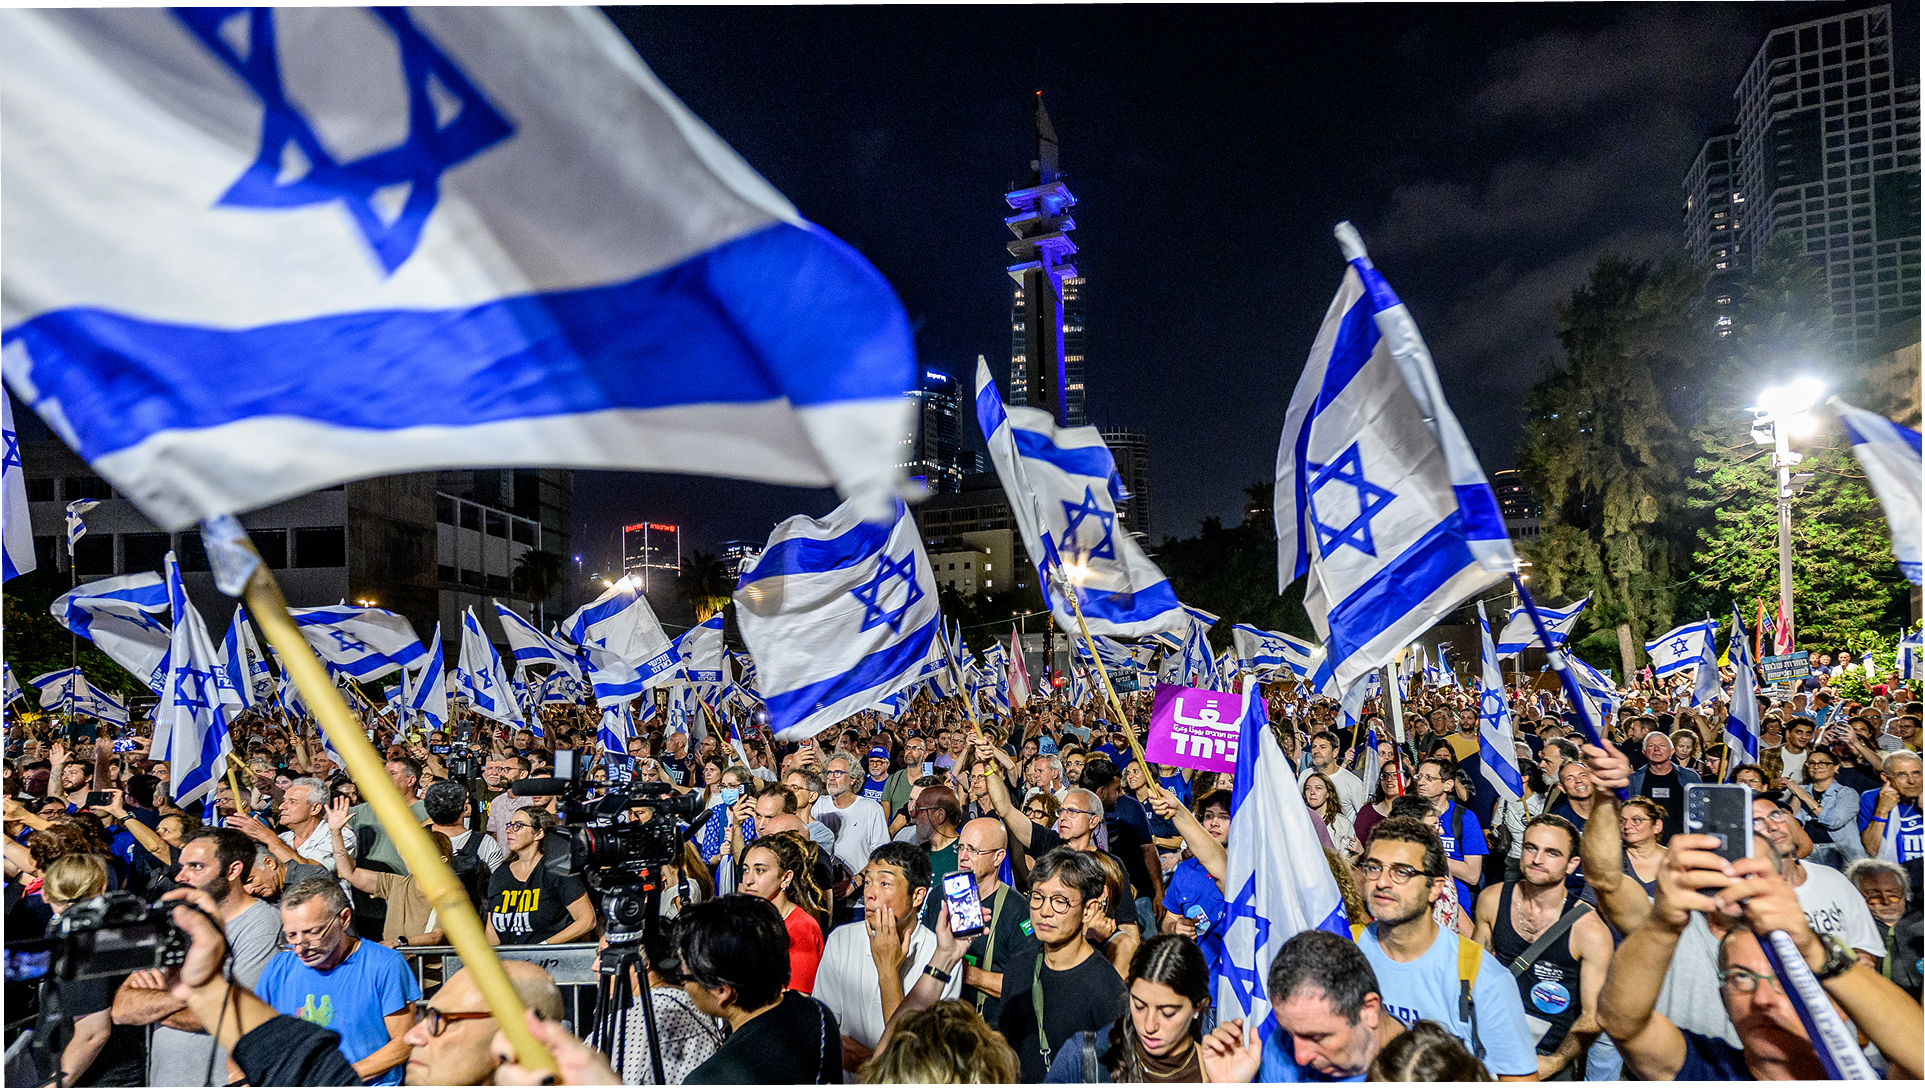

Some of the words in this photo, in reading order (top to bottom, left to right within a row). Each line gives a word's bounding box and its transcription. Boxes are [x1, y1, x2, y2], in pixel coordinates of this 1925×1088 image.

[647, 653, 670, 666] חופשי
[651, 659, 673, 674] בארצנו
[1764, 662, 1783, 671] שלום
[1170, 731, 1239, 763] ביחד
